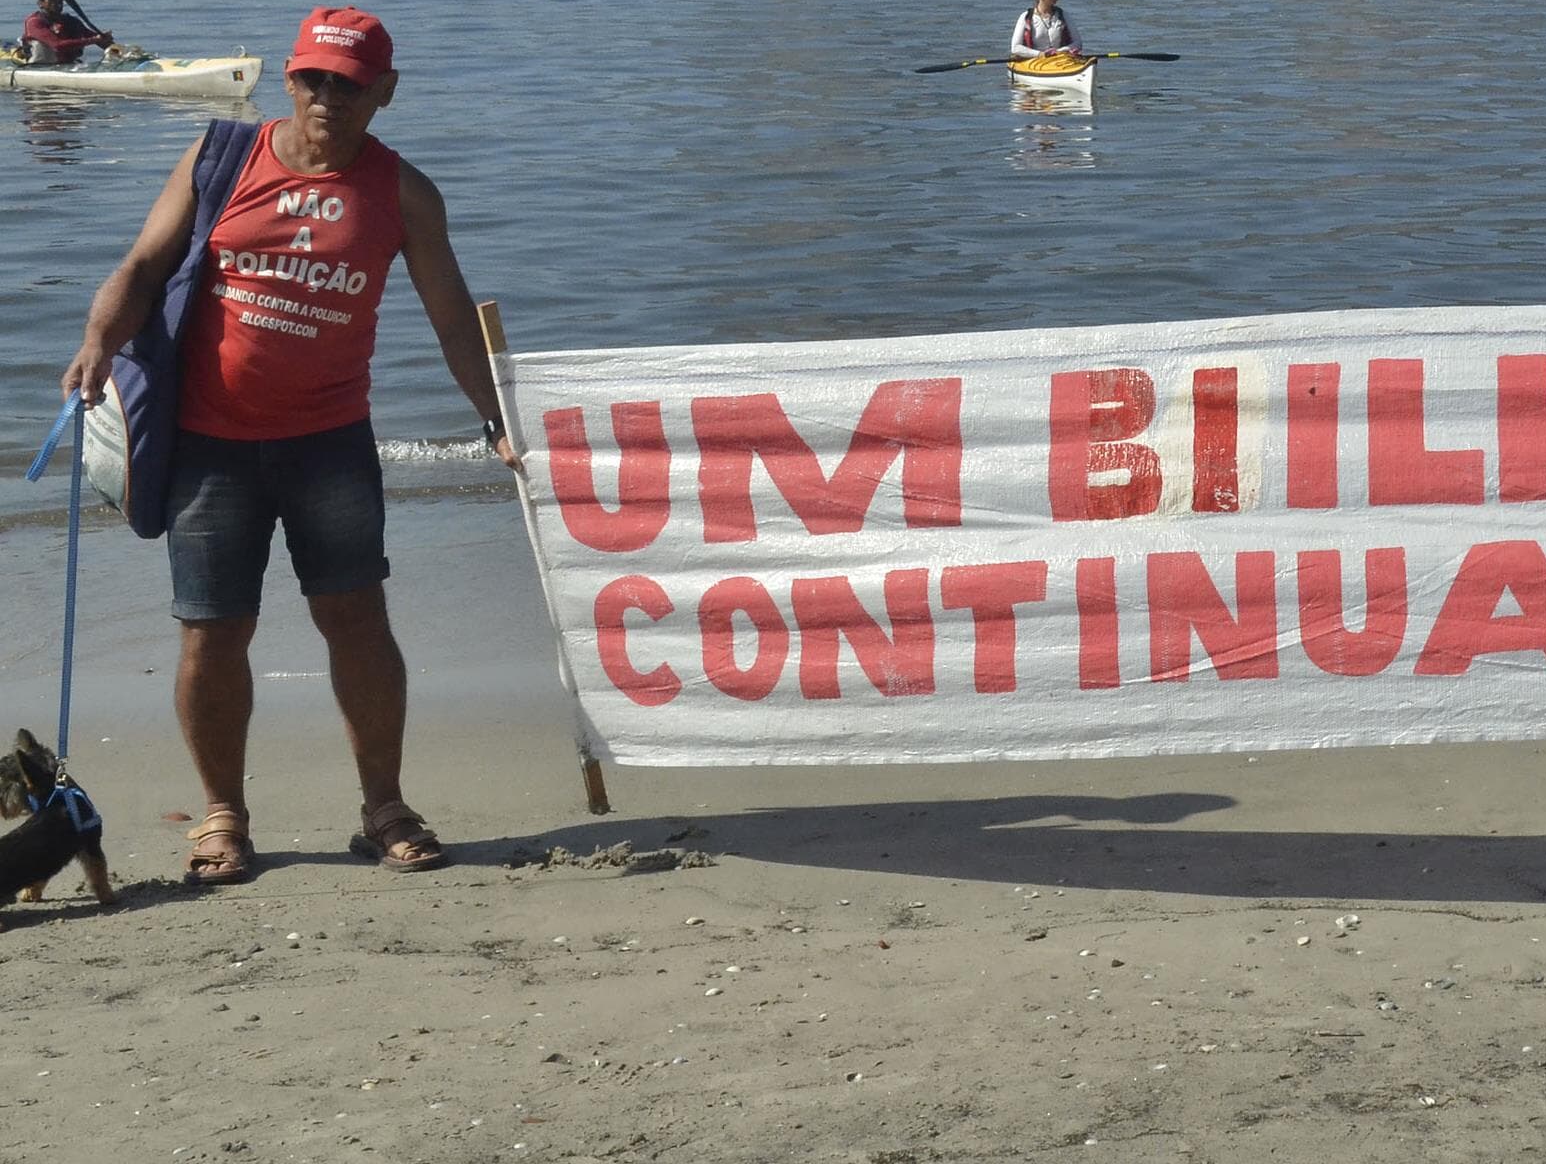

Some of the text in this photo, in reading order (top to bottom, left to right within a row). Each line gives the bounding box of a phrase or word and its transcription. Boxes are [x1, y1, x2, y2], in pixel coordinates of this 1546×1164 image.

[315, 34, 322, 43] A
[276, 189, 344, 222] NÃO
[289, 226, 312, 252] A
[218, 248, 367, 296] POLUIÇÃO
[212, 283, 255, 304] NADANDO
[257, 294, 299, 315] CONTRA
[300, 304, 308, 318] A
[239, 311, 318, 338] .BLOGSPOT.COM
[544, 378, 962, 552] UM
